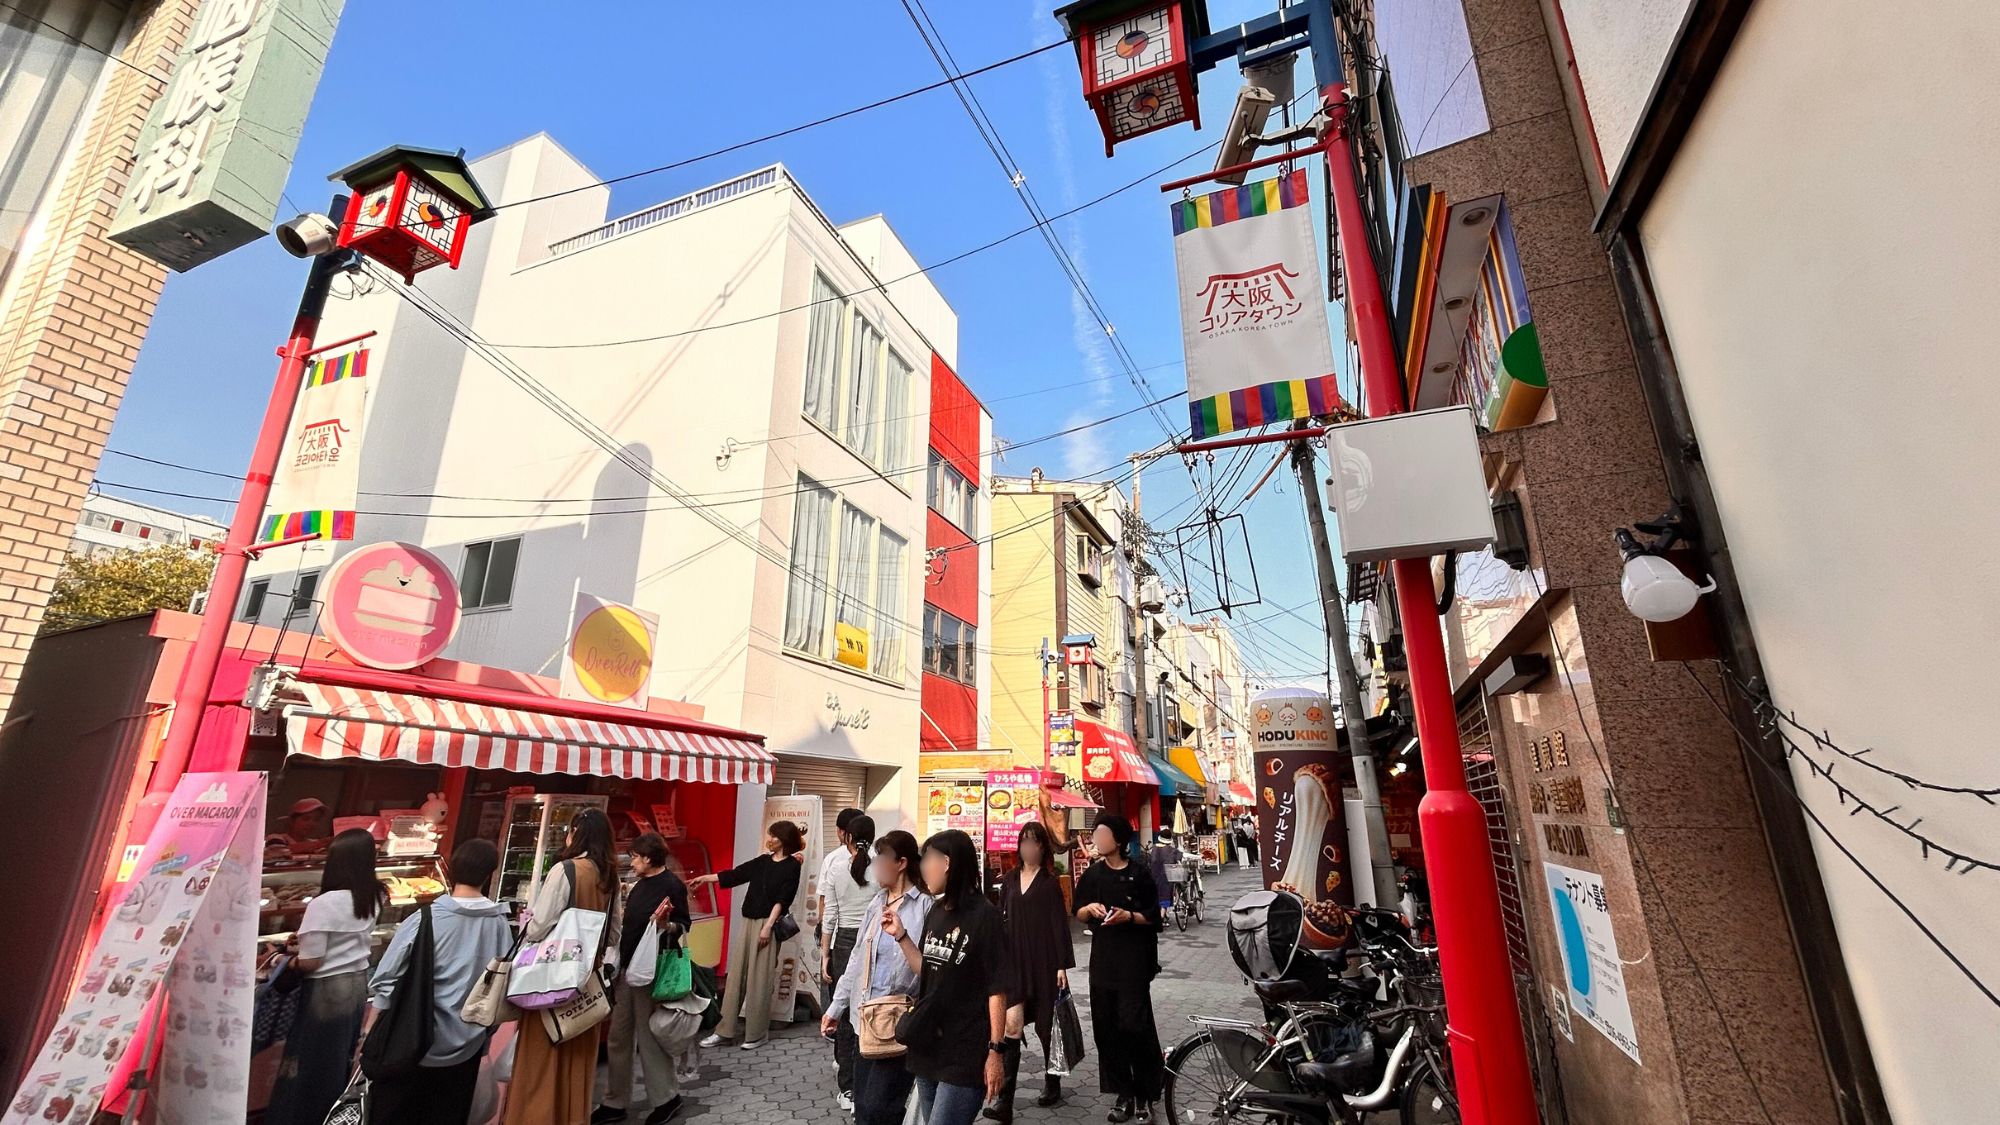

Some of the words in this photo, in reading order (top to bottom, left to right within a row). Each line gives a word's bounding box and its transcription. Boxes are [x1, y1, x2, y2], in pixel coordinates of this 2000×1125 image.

[1221, 283, 1274, 309] 大阪
[1199, 302, 1302, 333] コリアタウン
[1208, 328, 1236, 339] OSAKA
[1269, 319, 1294, 329] TOWN
[306, 434, 330, 451] 大阪
[293, 447, 340, 468] 코리아타운
[1257, 730, 1329, 743] HODUKING
[170, 806, 196, 819] OVER
[194, 806, 242, 820] MACARON
[1269, 791, 1294, 871] リアルチーズ
[572, 991, 591, 1006] THE
[560, 1003, 585, 1020] TOTE
